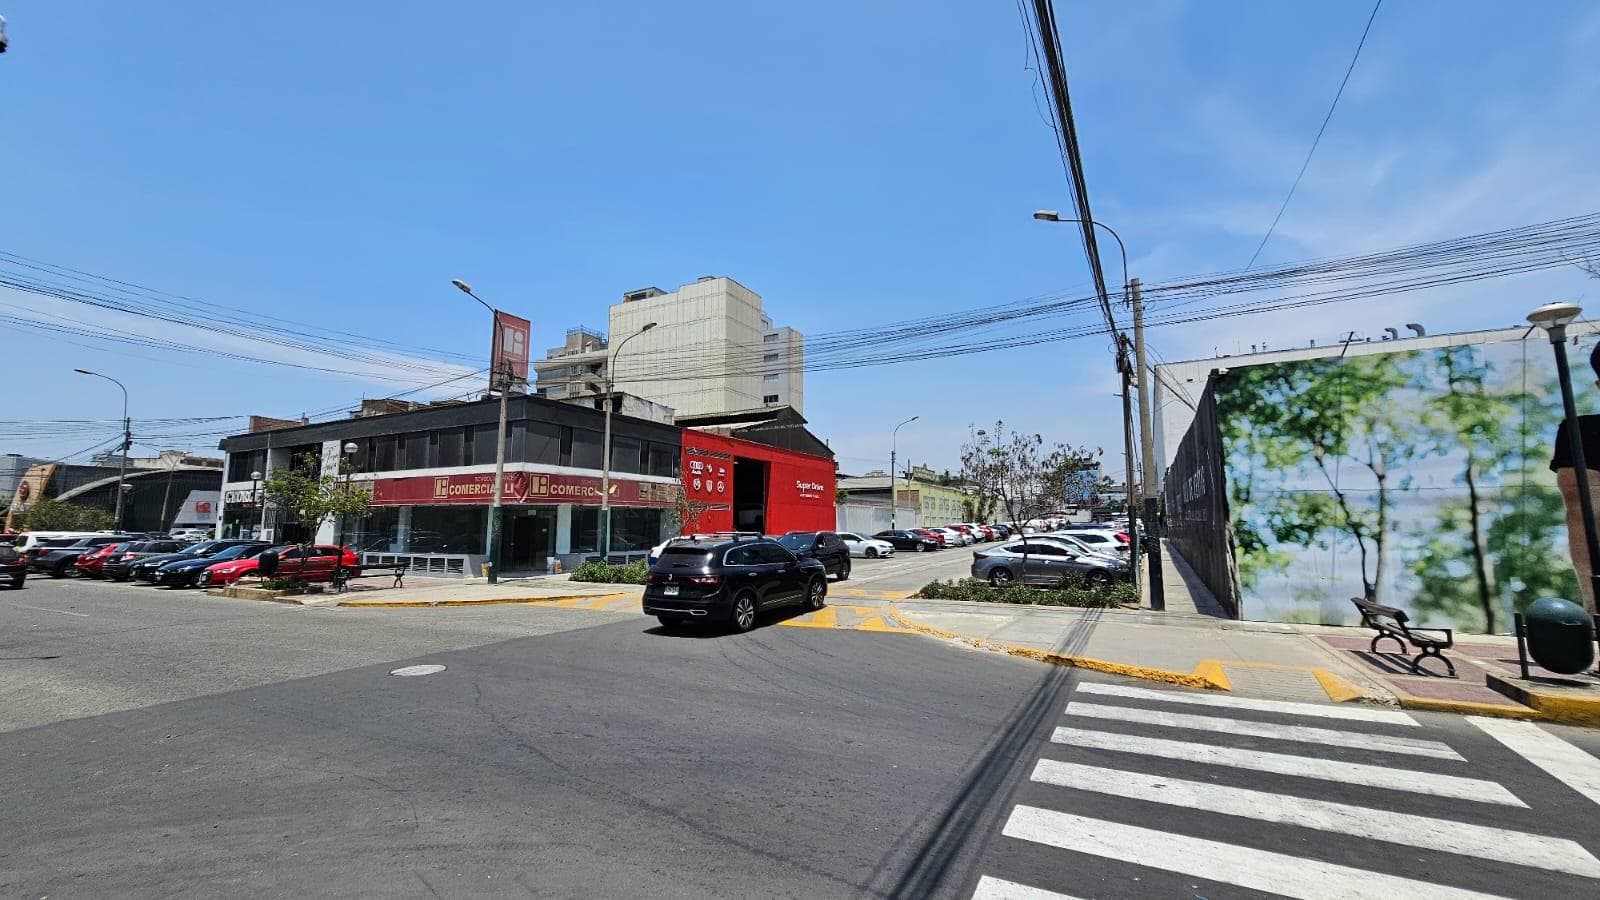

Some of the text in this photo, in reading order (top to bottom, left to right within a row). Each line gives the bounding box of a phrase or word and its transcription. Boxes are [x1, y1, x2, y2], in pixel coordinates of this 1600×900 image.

[449, 483, 499, 496] COMERCIA
[796, 480, 824, 493] Super Drive
